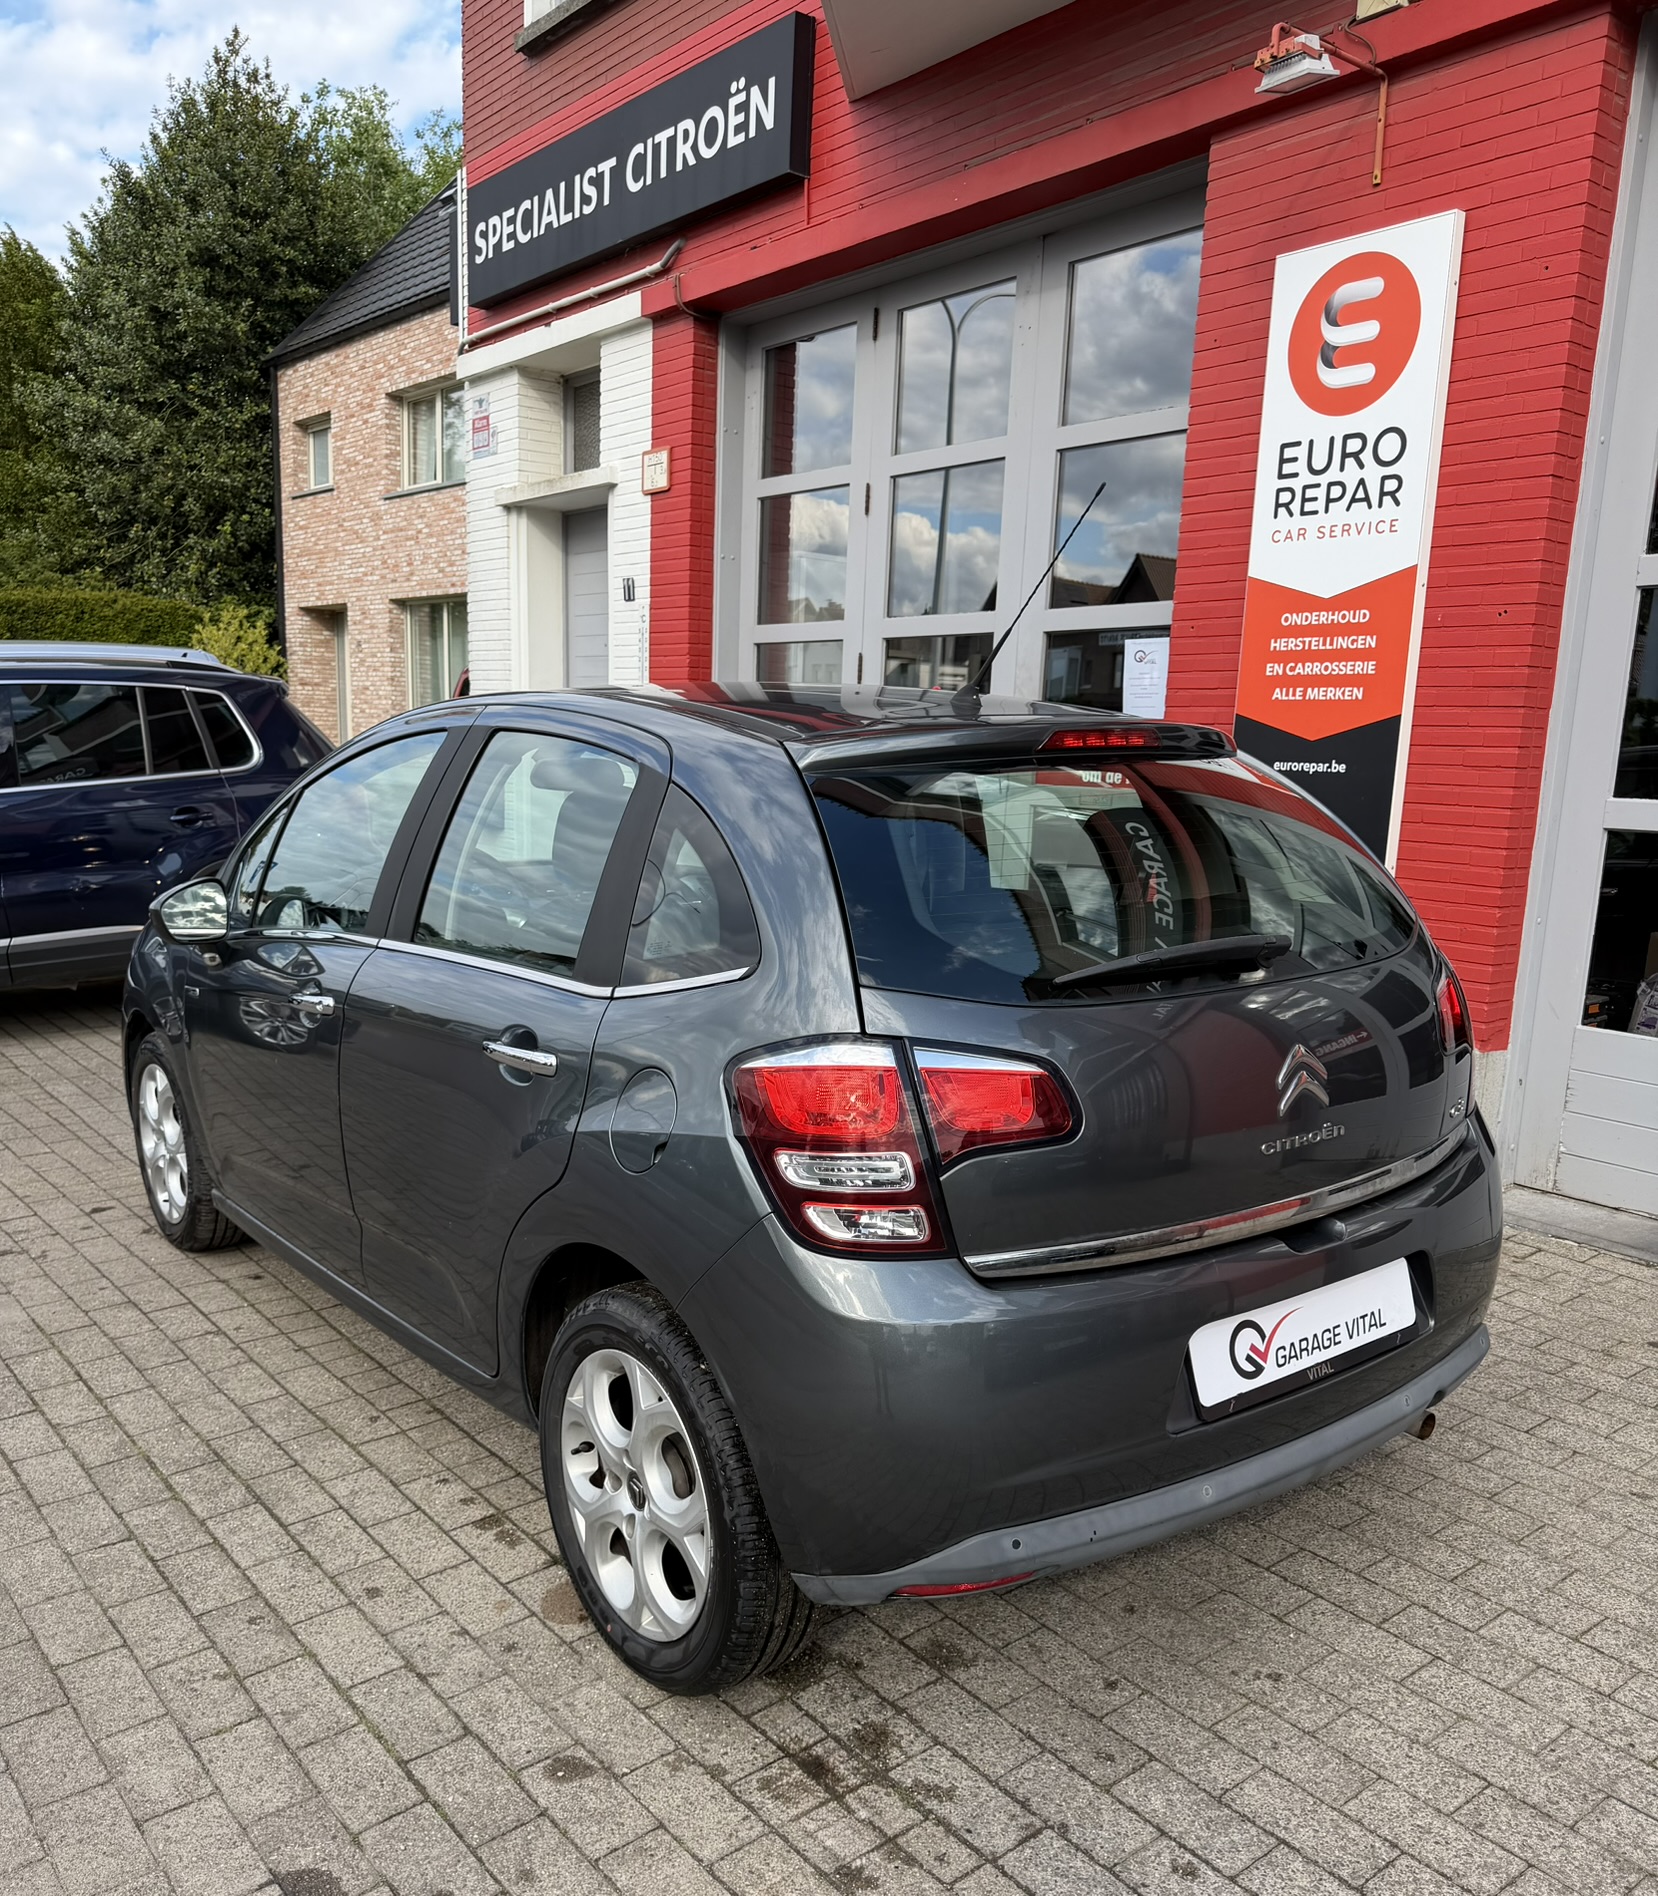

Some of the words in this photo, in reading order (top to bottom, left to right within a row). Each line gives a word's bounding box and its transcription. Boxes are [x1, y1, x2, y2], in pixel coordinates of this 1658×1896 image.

[474, 156, 617, 265] SPECIALIST
[625, 76, 776, 193] CITROËN
[1277, 426, 1407, 480] EURO
[1273, 473, 1404, 520] REPAR
[1271, 527, 1307, 544] CAR
[1316, 518, 1399, 540] SERVICE
[1280, 609, 1370, 626] ONDERHOUD
[1270, 635, 1377, 651] HERSTELLINGEN
[1265, 663, 1283, 676] EN
[1285, 661, 1377, 675] CARROSSERIE
[1271, 688, 1304, 701] ALLE
[1306, 687, 1364, 701] MERKEN
[1273, 760, 1347, 775] eurorepar.be
[1275, 1324, 1342, 1369] GARAGE
[1345, 1308, 1387, 1340] VITAL
[1306, 1362, 1334, 1381] VITAL
